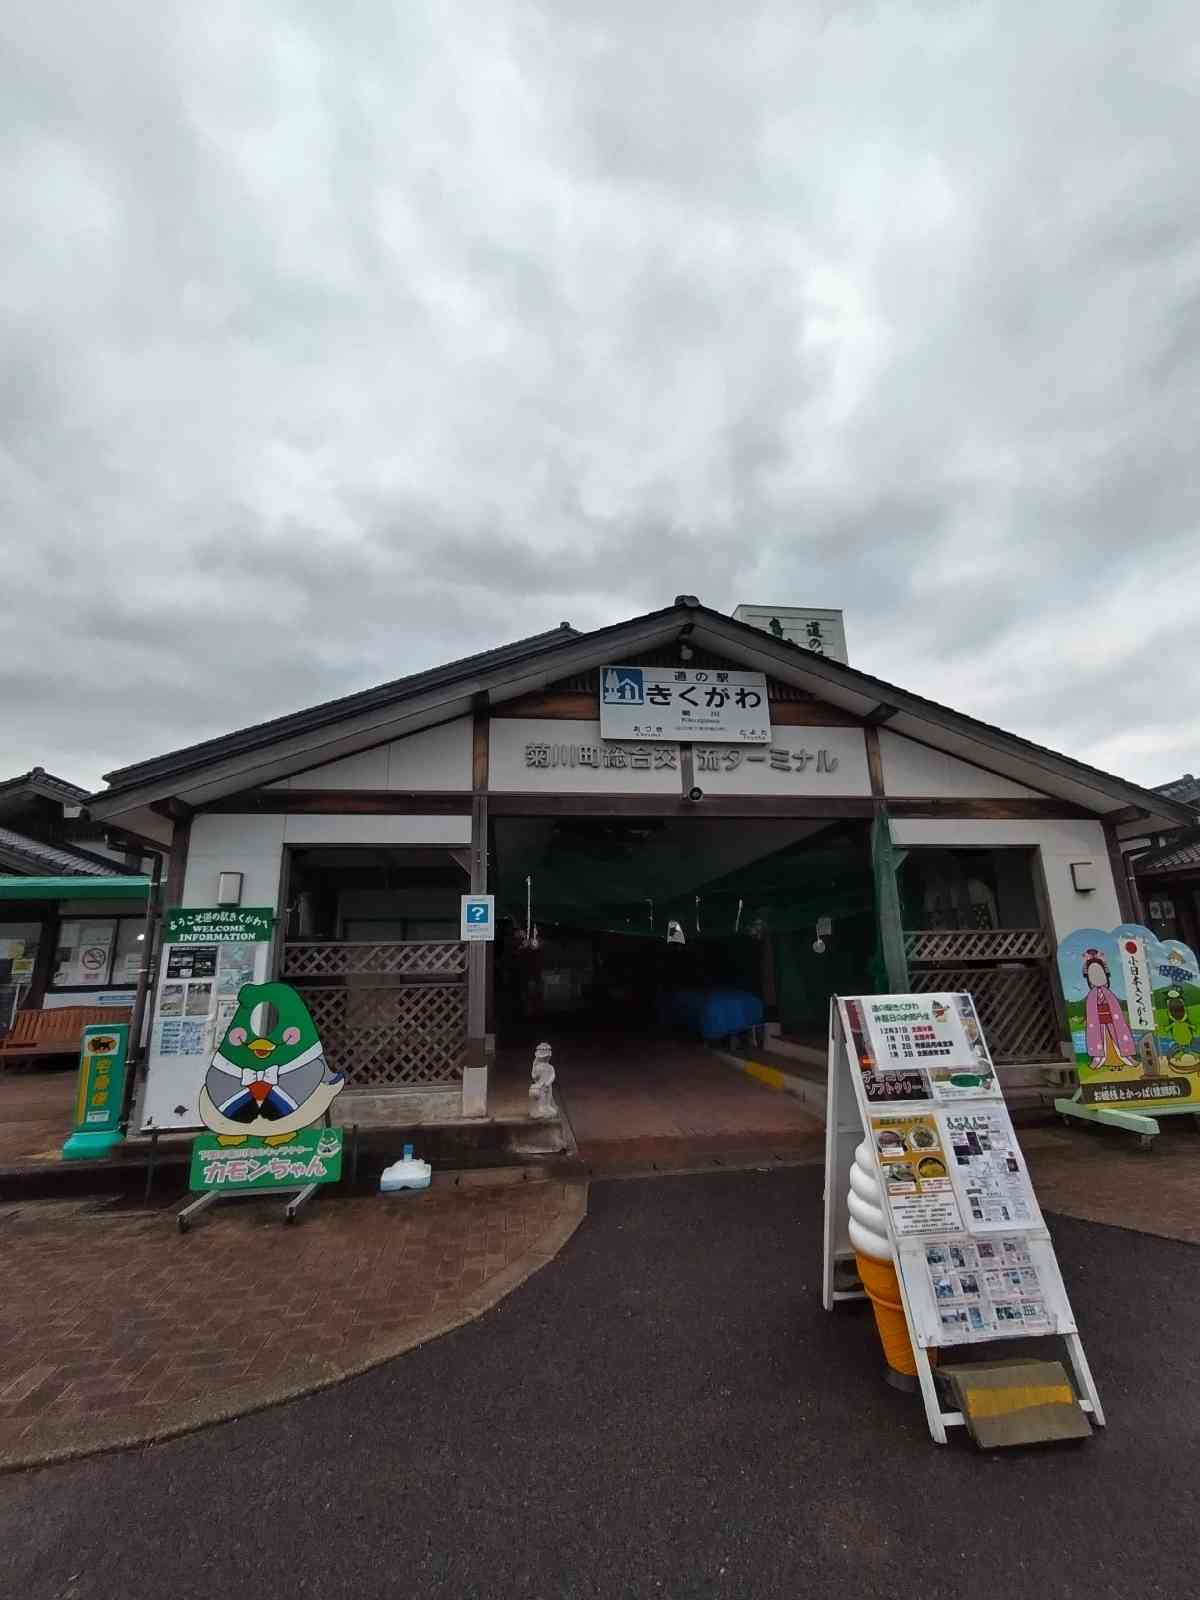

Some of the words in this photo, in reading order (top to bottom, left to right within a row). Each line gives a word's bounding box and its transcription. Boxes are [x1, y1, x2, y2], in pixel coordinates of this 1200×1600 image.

[807, 621, 824, 656] 道の
[674, 671, 729, 683] 道の駅
[646, 684, 761, 709] きくがわ
[179, 932, 257, 942] INFORMATION
[192, 925, 246, 933] WELCOME
[204, 1155, 328, 1184] カモンちゃん
